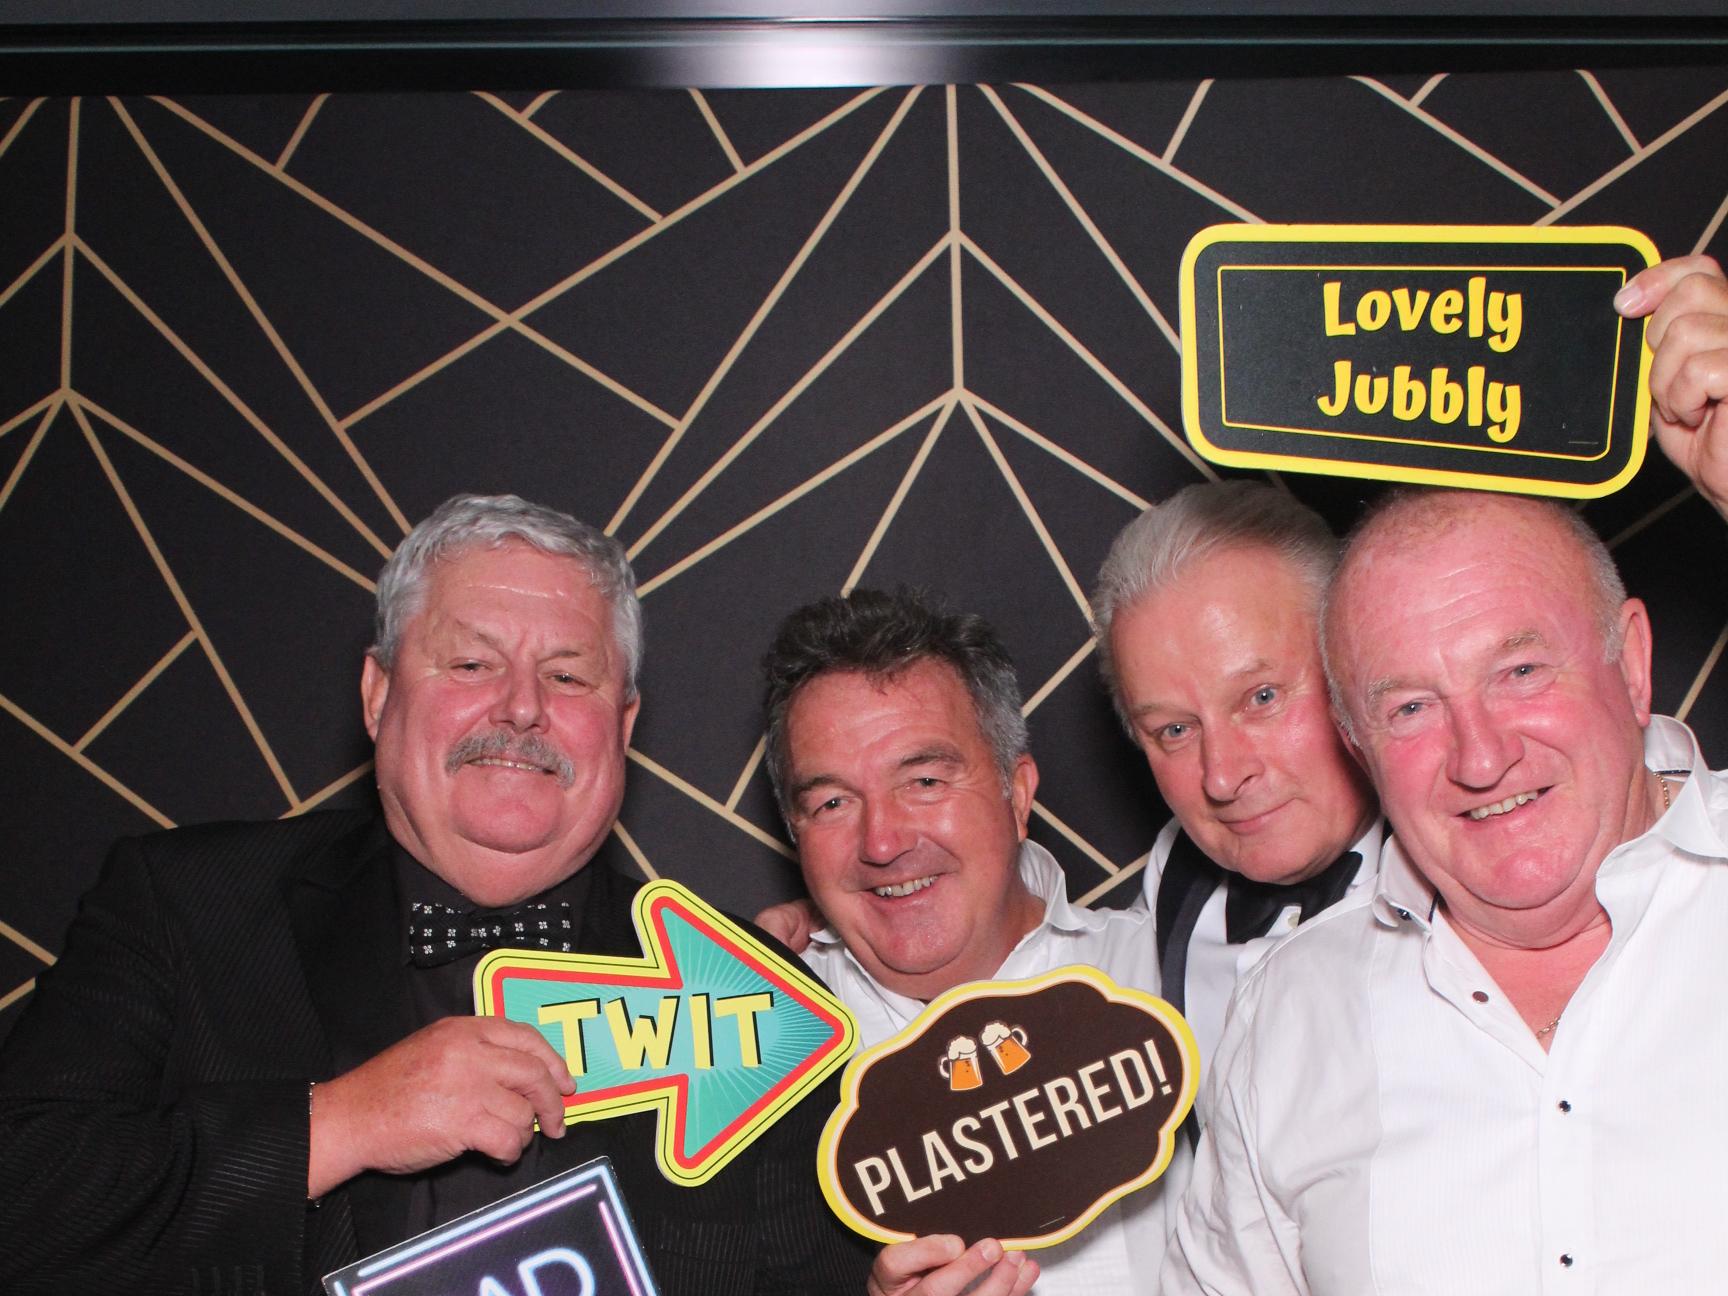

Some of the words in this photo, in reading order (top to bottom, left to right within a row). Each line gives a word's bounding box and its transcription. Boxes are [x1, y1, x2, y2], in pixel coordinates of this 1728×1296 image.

[1323, 276, 1522, 353] Lovely
[1317, 360, 1521, 443] Jubbly
[537, 991, 774, 1077] TWIT
[854, 1039, 1173, 1216] PLASTERED!
